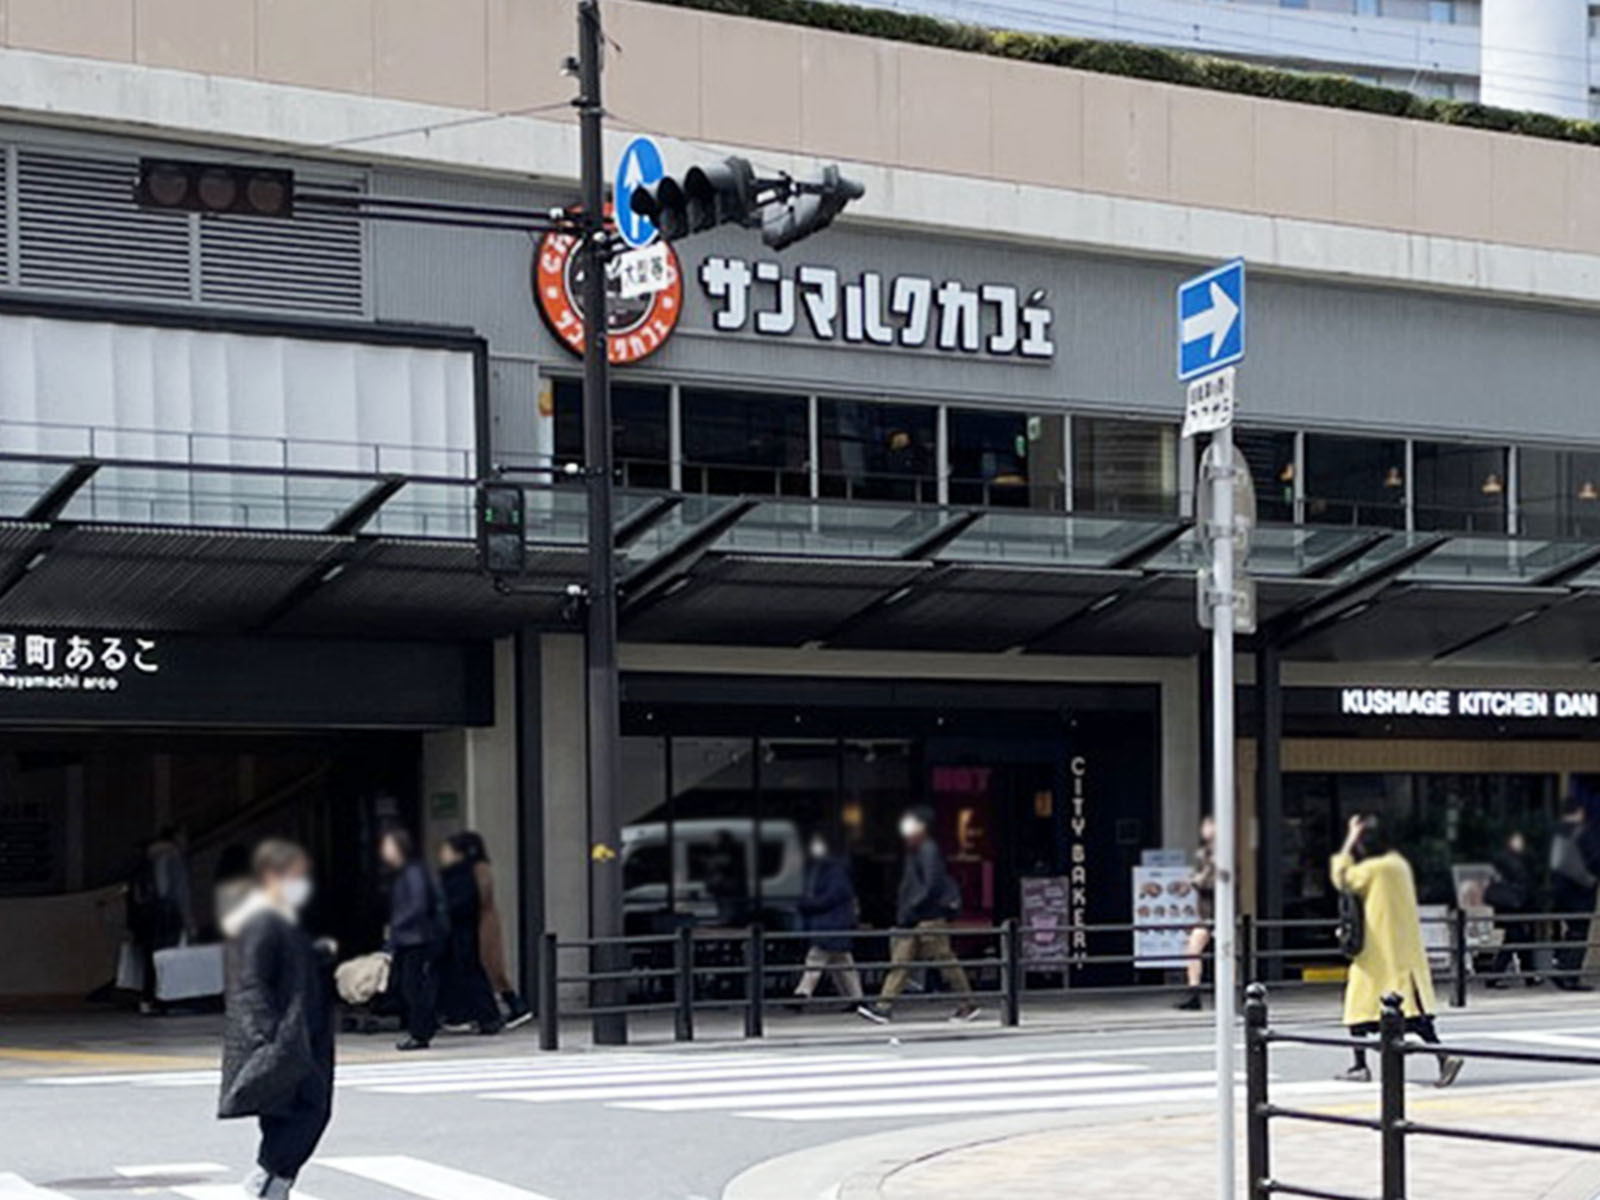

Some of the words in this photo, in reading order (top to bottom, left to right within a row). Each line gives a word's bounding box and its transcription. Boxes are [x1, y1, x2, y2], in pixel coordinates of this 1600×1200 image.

[701, 257, 1054, 356] サンマルクカフェ
[1342, 689, 1450, 715] KUSHIAGE
[1458, 690, 1548, 716] KITCHEN
[1555, 692, 1598, 716] DAN
[1071, 756, 1086, 836] CITY
